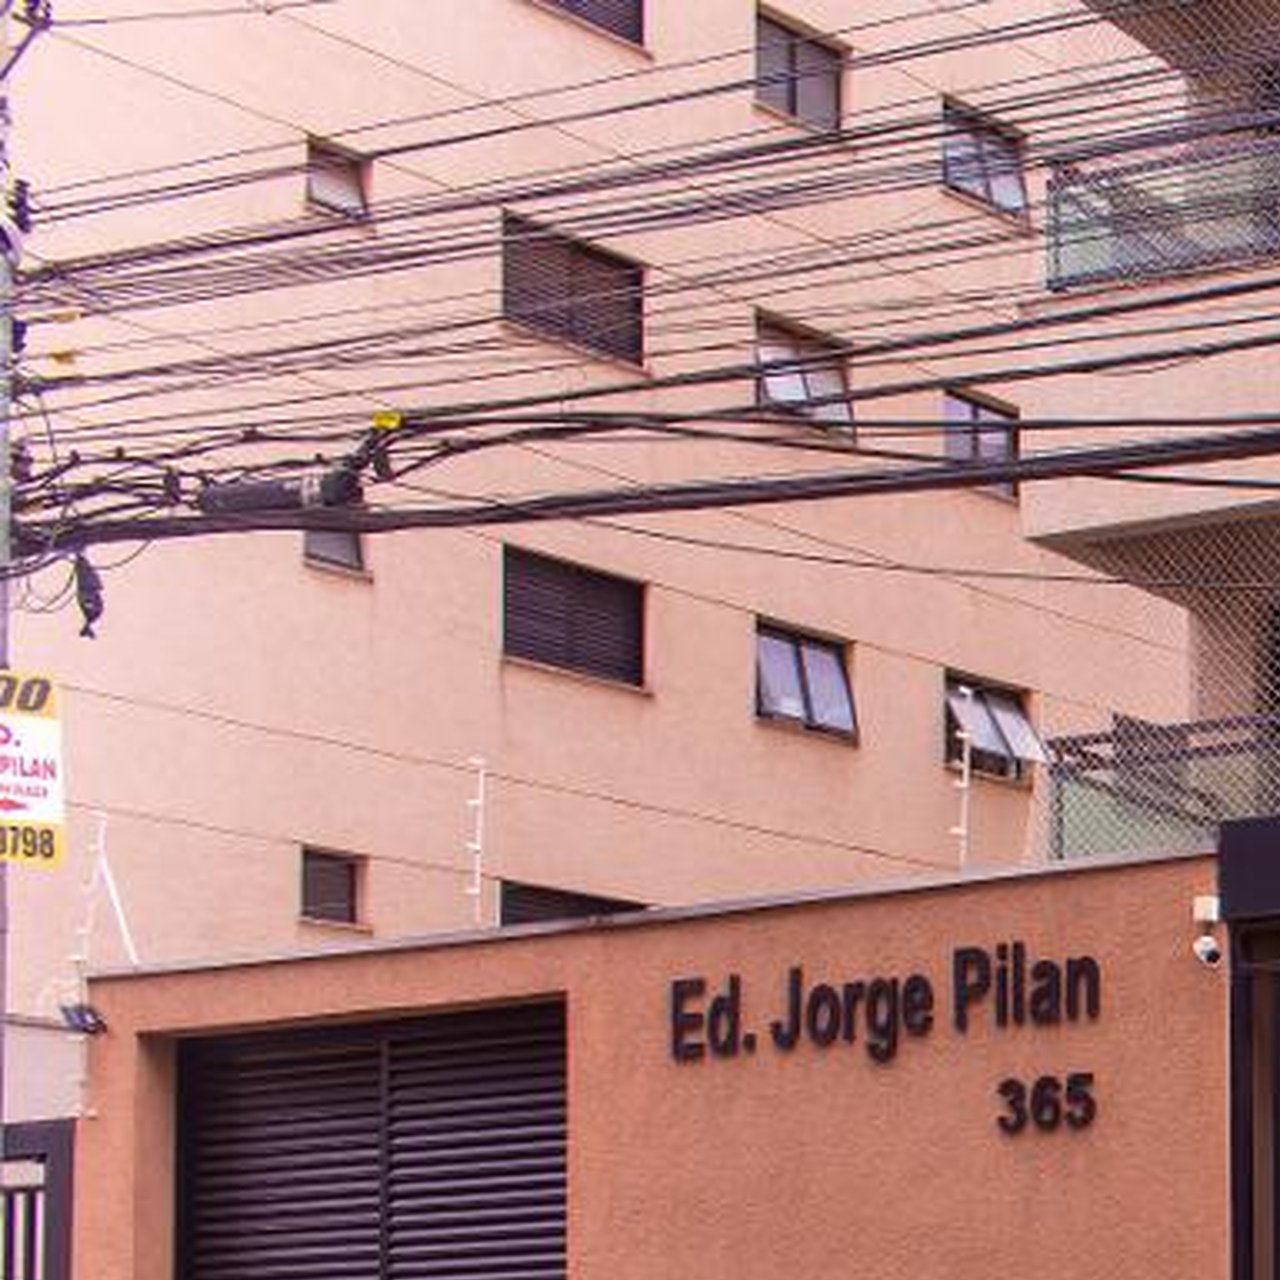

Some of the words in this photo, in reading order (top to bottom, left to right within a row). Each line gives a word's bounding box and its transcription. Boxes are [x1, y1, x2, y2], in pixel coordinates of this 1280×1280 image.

[670, 975, 757, 1063] Ed.
[769, 965, 935, 1063] Jorge
[952, 941, 1101, 1034] Pilan
[996, 1072, 1097, 1135] 365
